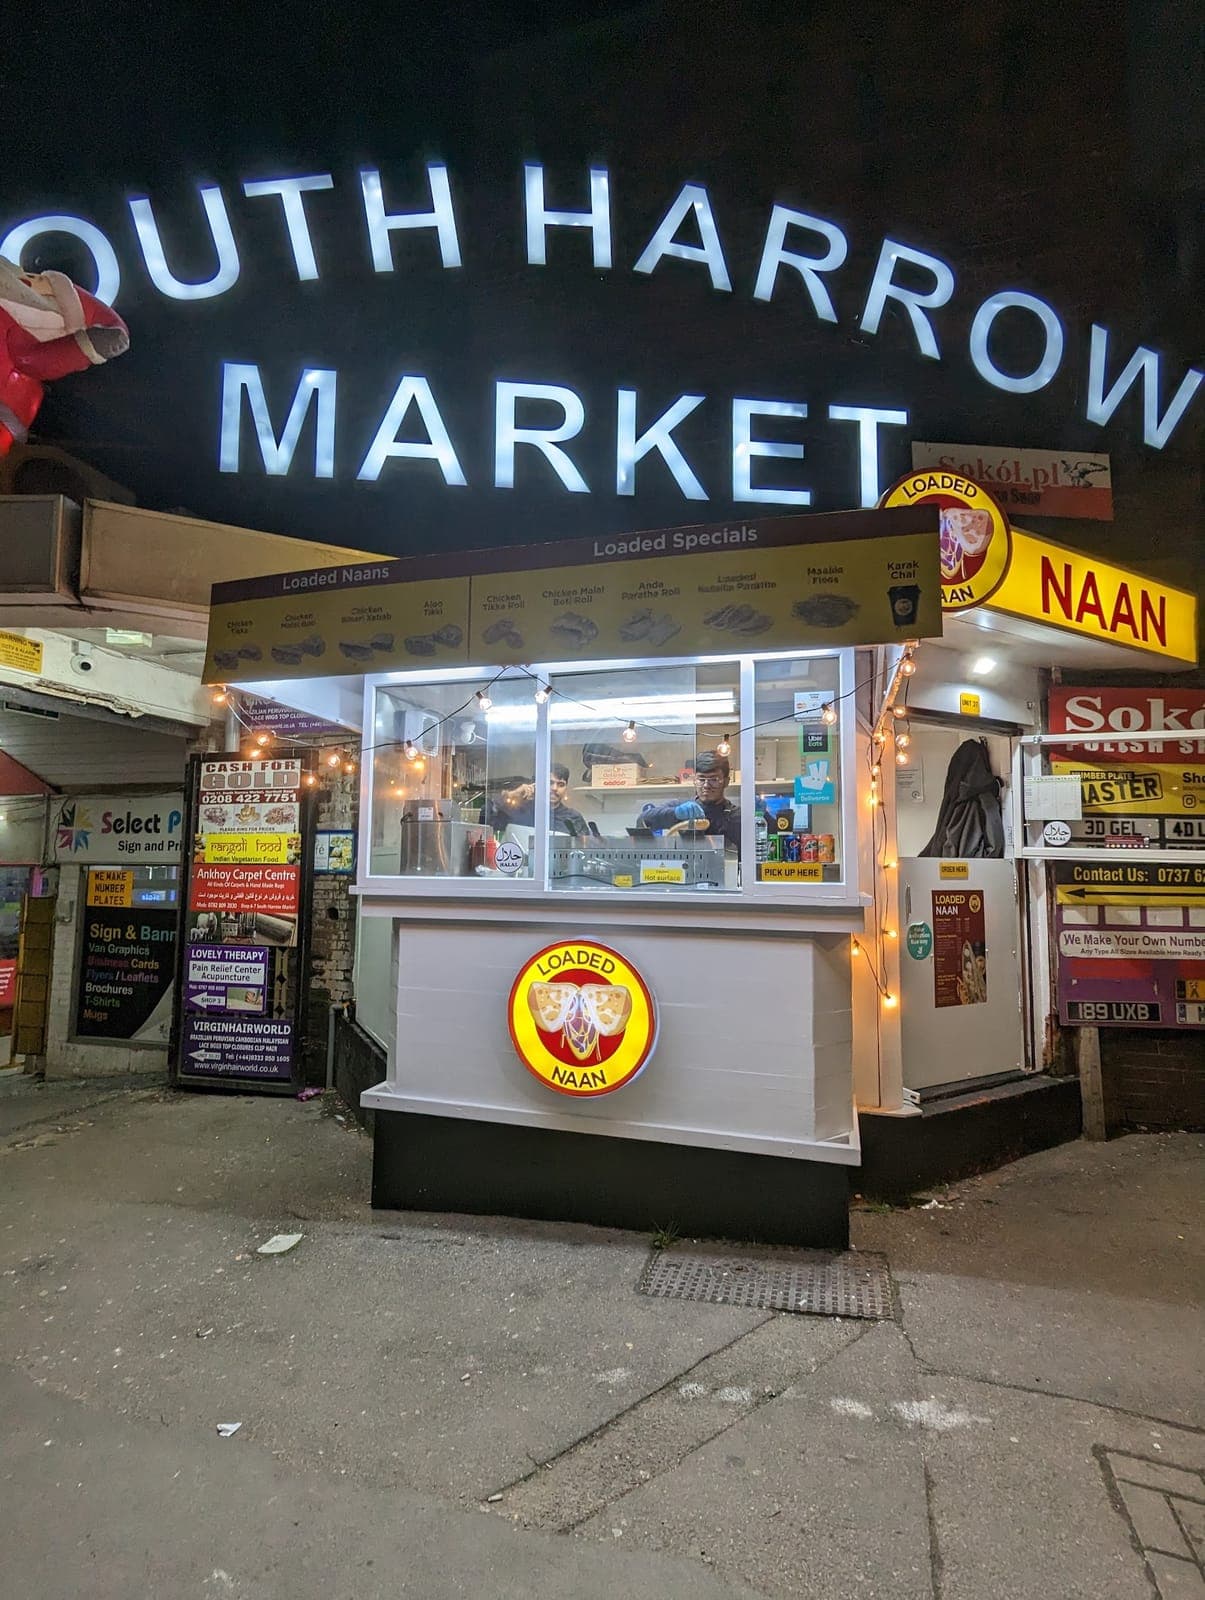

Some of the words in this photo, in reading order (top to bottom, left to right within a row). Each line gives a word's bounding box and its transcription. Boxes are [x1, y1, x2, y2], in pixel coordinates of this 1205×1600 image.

[524, 164, 1204, 450] HARROW
[219, 362, 908, 507] MARKET
[902, 474, 978, 499] LOADED
[593, 536, 666, 557] Loaded
[673, 526, 758, 550] Specials
[887, 560, 919, 571] Karak
[282, 568, 338, 591] Loaded
[342, 566, 390, 583] Naans
[638, 580, 664, 590] Anda
[486, 594, 521, 603] Chicken
[542, 588, 578, 599] Chicken
[574, 595, 593, 604] Roll
[621, 589, 659, 601] Paratha
[661, 587, 681, 597] Roll
[941, 584, 974, 604] AAN
[508, 600, 525, 609] Roll
[1041, 555, 1167, 647] NAAN
[351, 606, 383, 615] Chicken
[206, 762, 253, 772] CASH
[260, 761, 296, 771] FOR
[202, 771, 299, 789] GOLD
[1108, 771, 1133, 780] PLATE
[202, 794, 233, 804] 0208
[235, 793, 260, 803] 422
[264, 793, 297, 802] 7751
[101, 811, 161, 834] Select
[1084, 820, 1105, 835] 3D
[1110, 821, 1142, 836] GEL
[1173, 821, 1193, 837] 4D
[118, 840, 141, 854] Sign
[144, 840, 164, 851] and
[210, 837, 248, 856] rangoli
[256, 836, 282, 852] food
[231, 855, 263, 863] Vegetarian
[94, 871, 104, 880] WE
[106, 872, 127, 881] MAKE
[197, 868, 231, 882] Ankhoy
[232, 868, 262, 882] Carpet
[264, 868, 296, 881] Centre
[764, 868, 782, 877] PICK
[784, 868, 795, 877] UP
[797, 868, 819, 877] HERE
[1073, 866, 1123, 881] Contact
[1127, 867, 1149, 882] Us:
[1158, 868, 1190, 883] 0737
[94, 883, 126, 893] NUMBER
[93, 895, 124, 905] PLATES
[935, 895, 966, 905] LOADED
[935, 905, 959, 916] NAAN
[90, 923, 122, 942] Sign
[125, 924, 136, 940] &
[1063, 933, 1081, 945] We
[1083, 933, 1112, 945] Make
[1114, 934, 1140, 946] Your
[1142, 935, 1167, 946] Own
[88, 942, 106, 953] Van
[107, 943, 150, 957] Graphics
[191, 949, 223, 959] LOVELY
[223, 950, 264, 961] THERAPY
[130, 958, 160, 969] Cards
[192, 963, 209, 972] Pain
[210, 964, 233, 973] Relief
[234, 965, 262, 974] Center
[536, 950, 616, 976] LOADED
[121, 971, 159, 983] Leaflets
[201, 972, 251, 982] Acupuncture
[85, 982, 133, 995] Brochures
[84, 995, 121, 1008] T-Shirts
[83, 1008, 108, 1021] Mugs
[1111, 1003, 1149, 1020] UXB
[193, 1020, 291, 1035] VIRGINHAIRWORLD
[194, 1062, 279, 1073] www.virginhairworld.co.uk
[551, 1066, 607, 1089] NAAN
